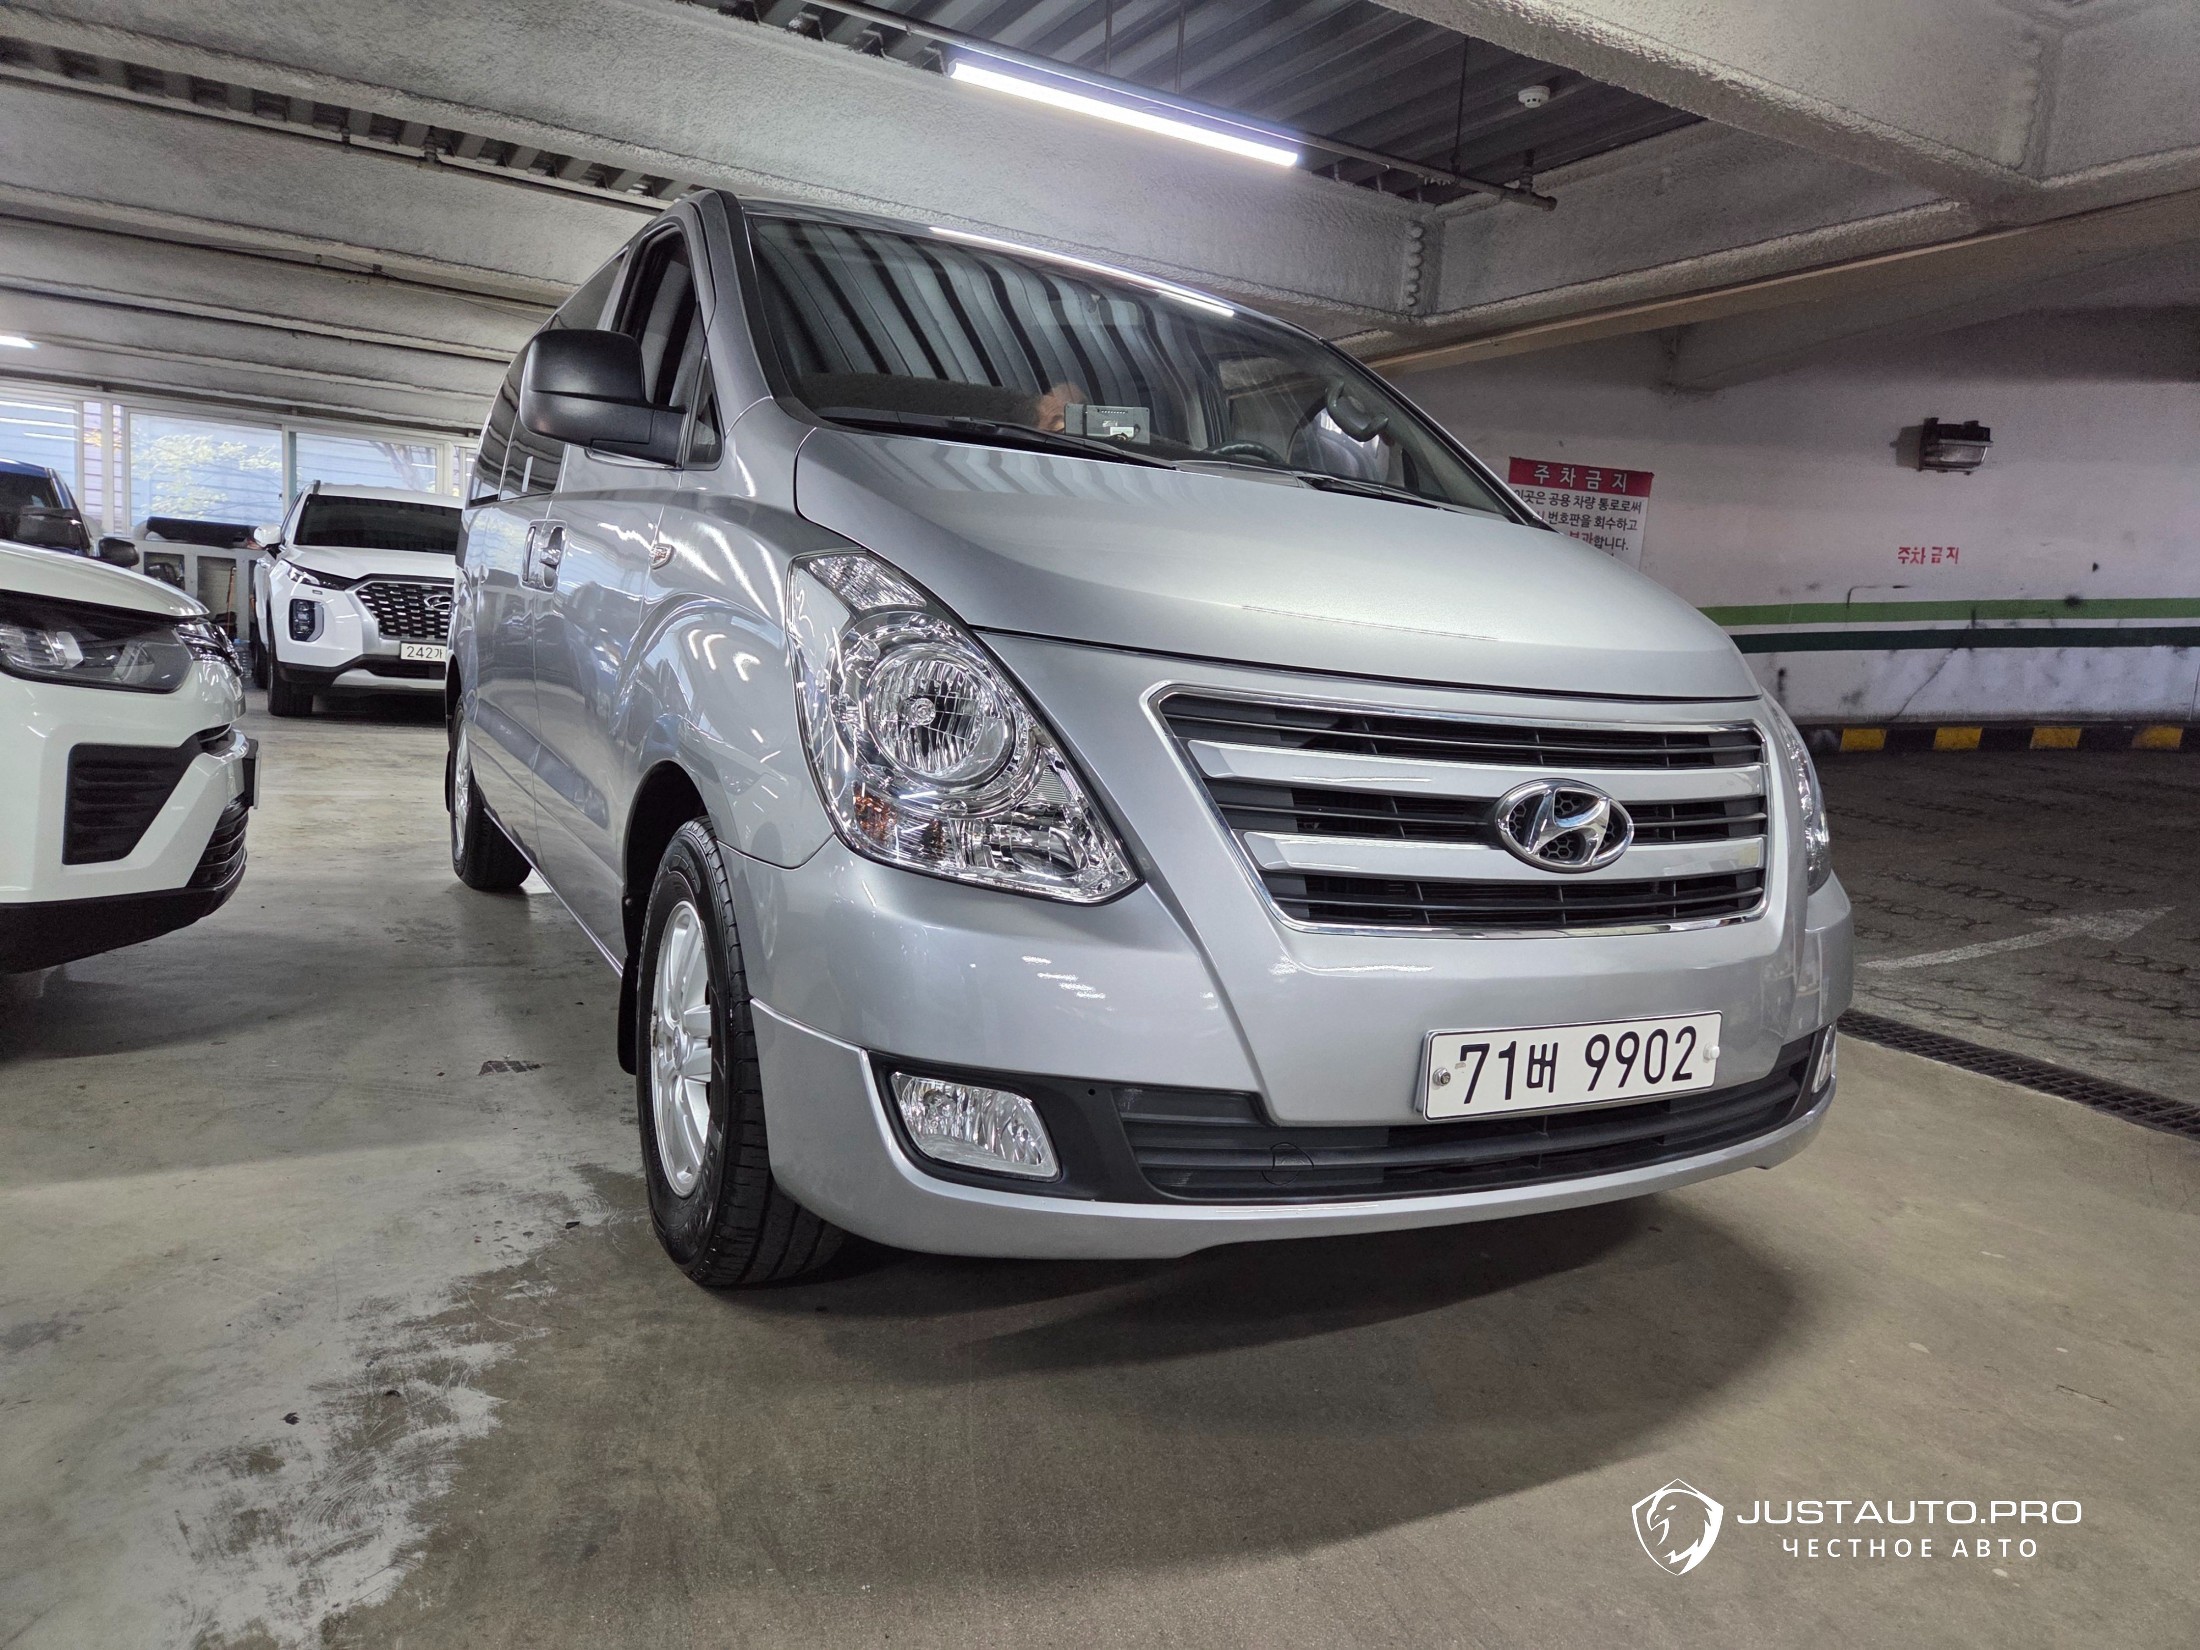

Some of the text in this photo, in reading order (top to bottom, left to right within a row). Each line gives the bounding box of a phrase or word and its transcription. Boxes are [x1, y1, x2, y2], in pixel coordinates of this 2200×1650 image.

[1548, 492, 1571, 508] 공용
[1573, 495, 1596, 510] 차량
[1598, 498, 1642, 514] 통로로써
[1548, 510, 1592, 528] 번호판을
[1593, 515, 1638, 531] 회수하고
[1459, 1025, 1697, 1105] 71버 9902
